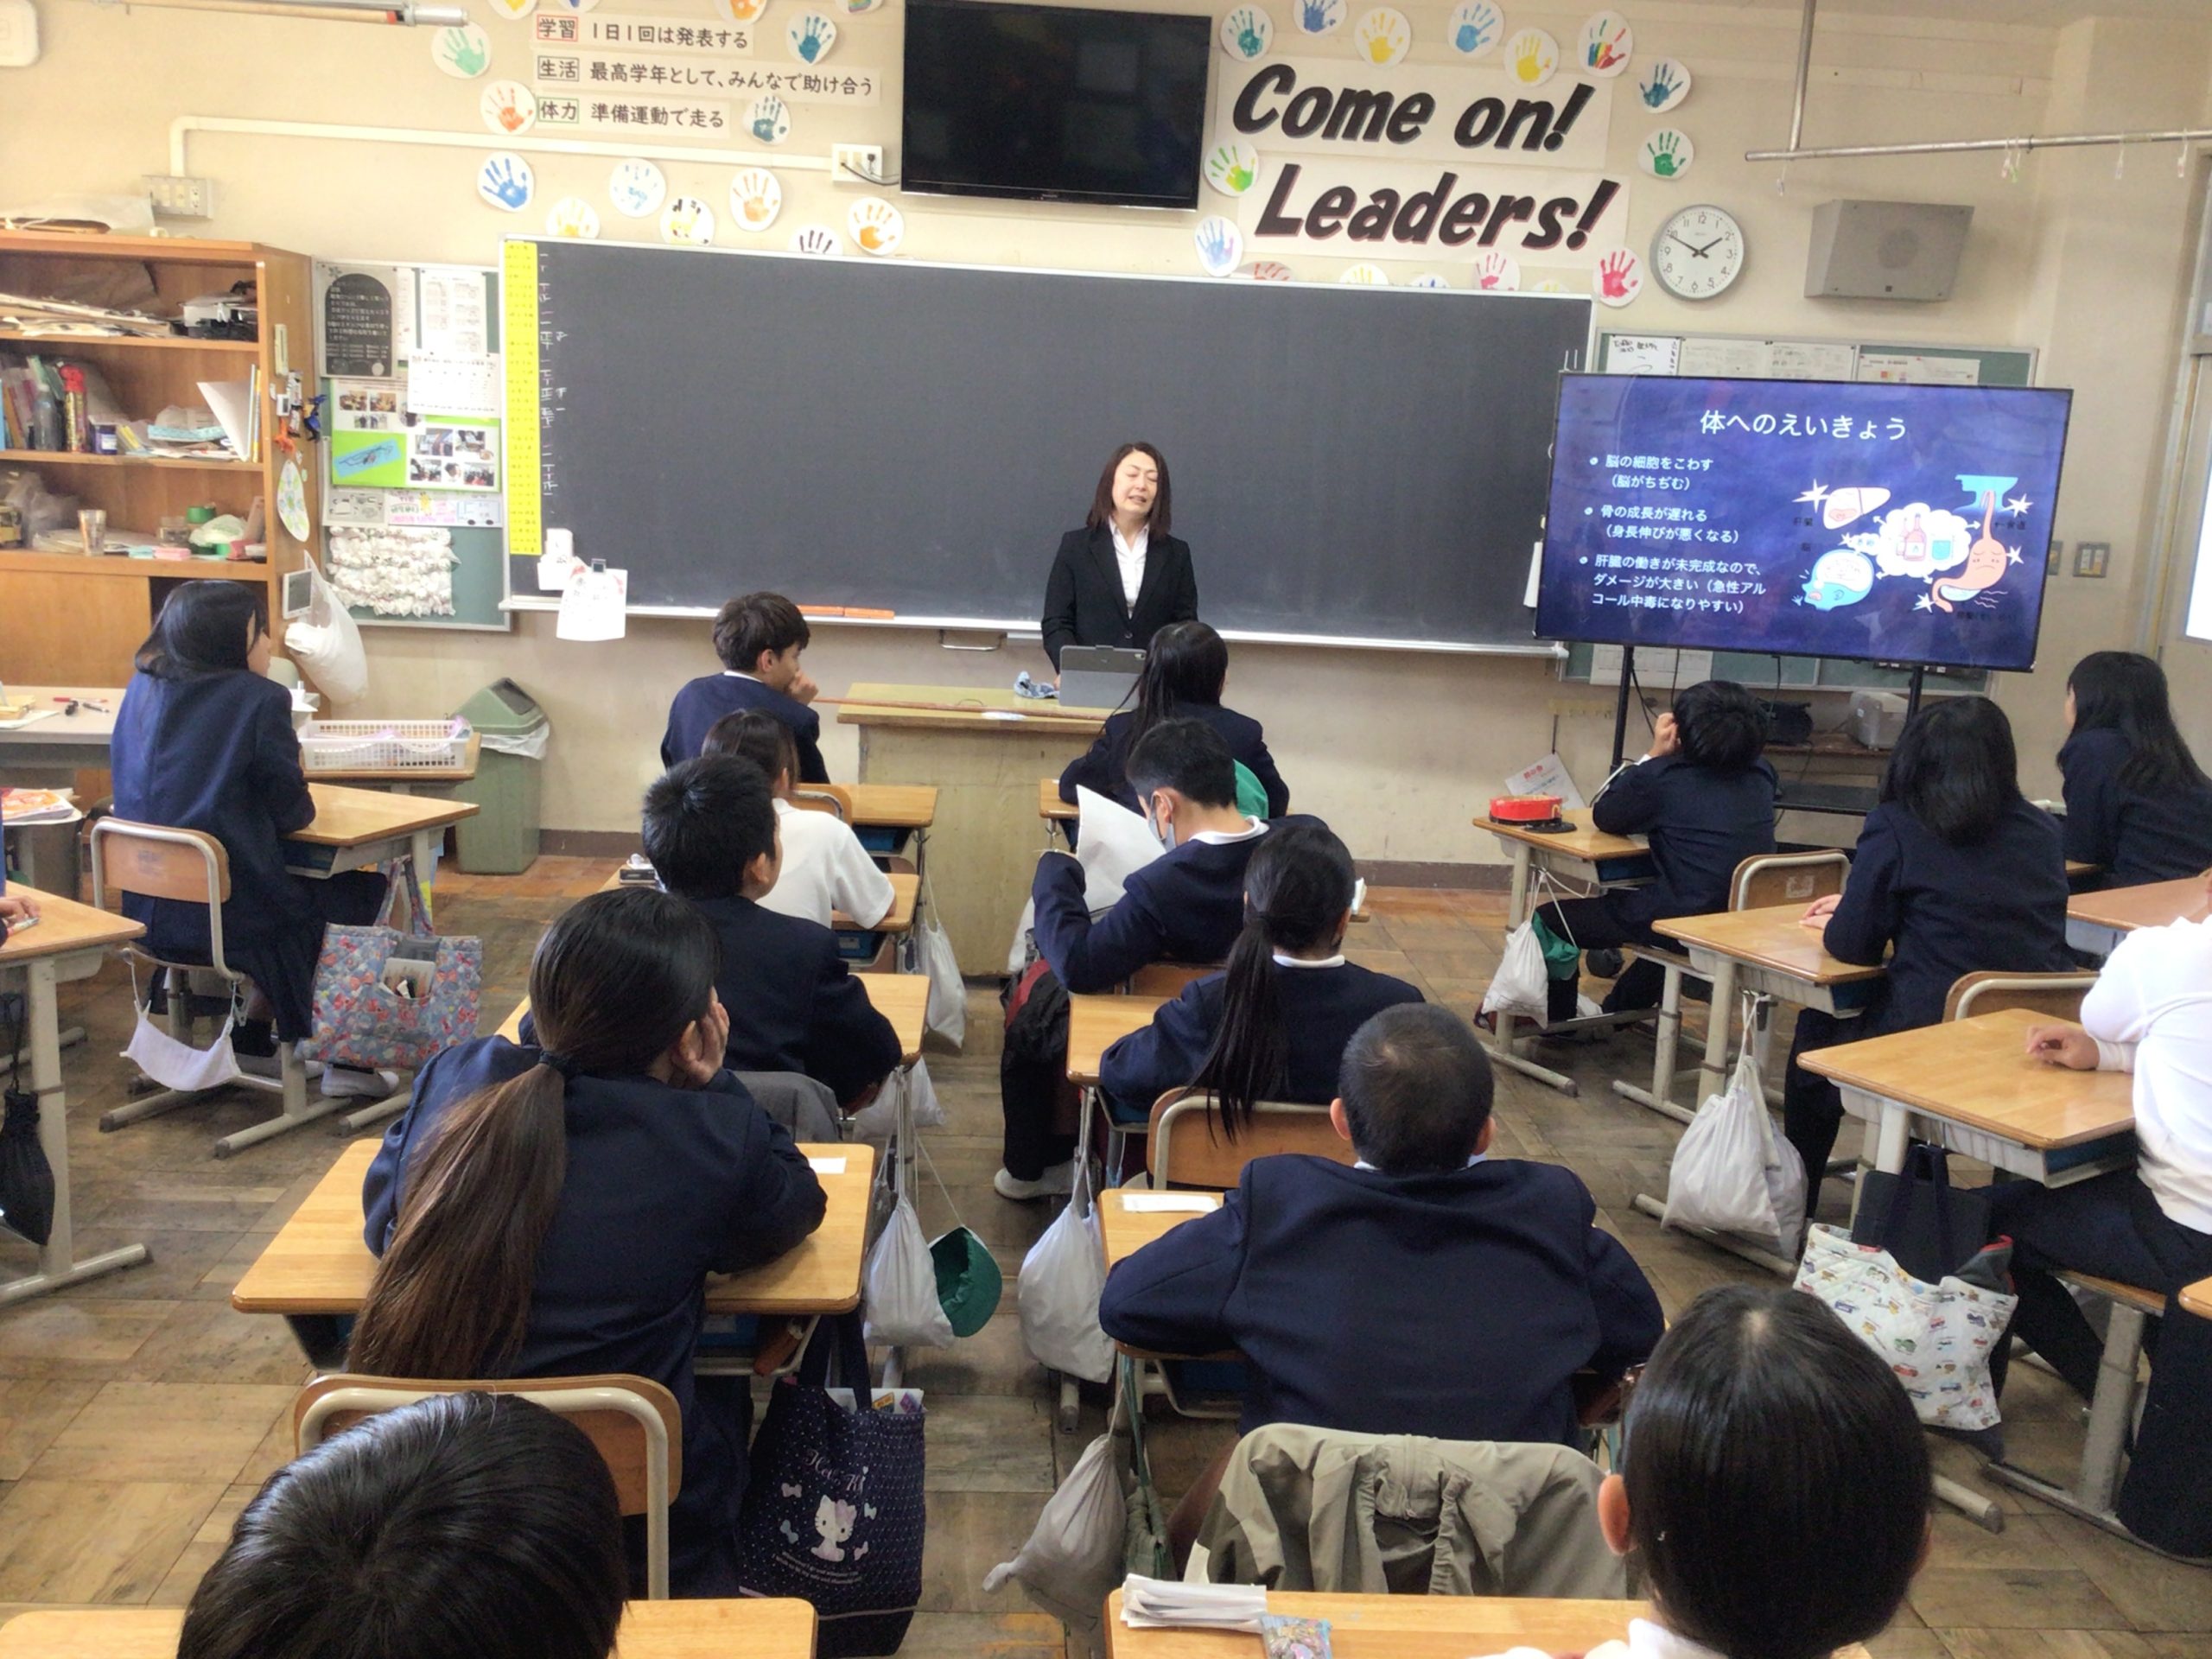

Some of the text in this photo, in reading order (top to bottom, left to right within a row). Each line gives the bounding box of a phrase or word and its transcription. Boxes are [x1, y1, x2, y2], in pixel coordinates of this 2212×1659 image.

[538, 18, 748, 48] 学習 1日1回は発表する
[540, 60, 872, 95] 生活 最高学年として、みんなで助け合う
[540, 100, 724, 128] 体力 準備運動で走る
[1232, 64, 1596, 153] Come on!
[1254, 162, 1621, 251] Leaders!
[1698, 214, 1707, 225] 12
[1725, 231, 1731, 241] 2
[1664, 246, 1671, 256] 9
[1726, 249, 1733, 259] 3
[1666, 263, 1673, 273] 8
[1720, 266, 1727, 275] 4
[1677, 276, 1683, 284] 7
[1691, 281, 1699, 291] 6
[1707, 276, 1715, 289] 5
[1700, 410, 1906, 440] 体へのえいきょう
[1605, 454, 1713, 471] 脳の細胞をこわす
[1611, 474, 1690, 490] （脳がちぢむ）
[1601, 505, 1707, 522] 骨の成長が遅れる
[1606, 524, 1739, 543] （身長伸びが悪くなる）
[1594, 553, 1762, 575] 肝臓の働きが未完成なので、
[1592, 593, 1744, 613] コール中毒になりやすい）
